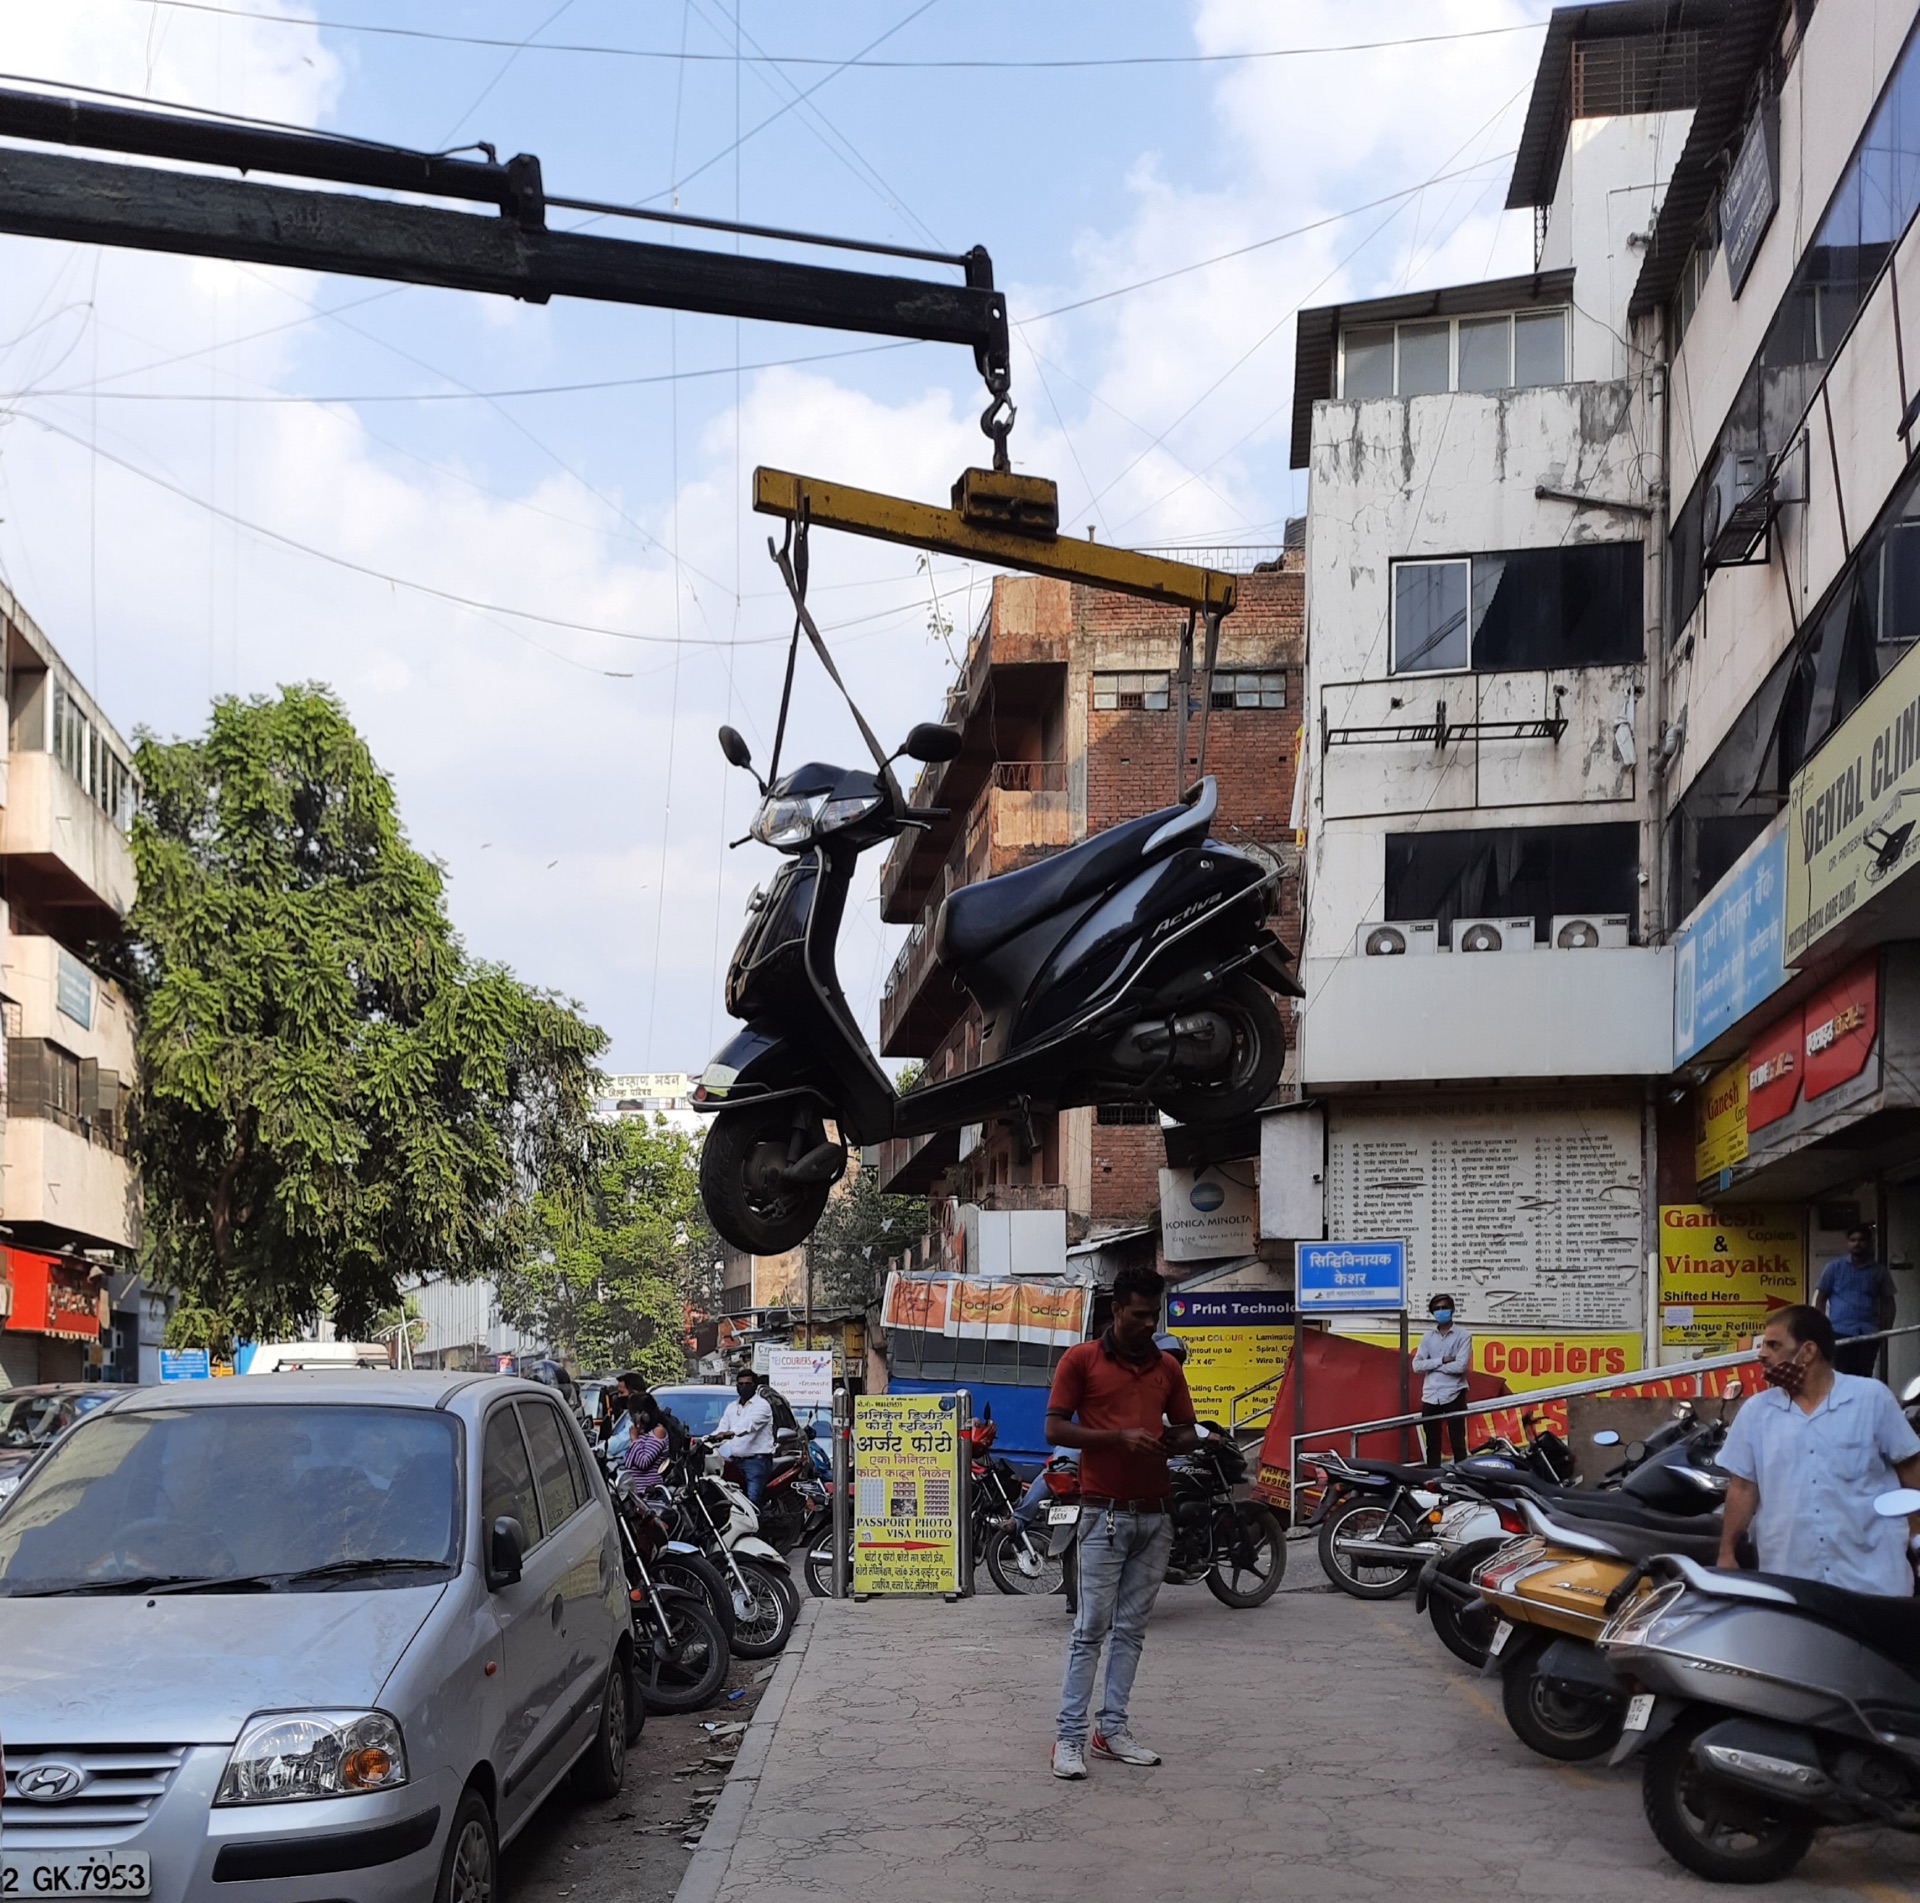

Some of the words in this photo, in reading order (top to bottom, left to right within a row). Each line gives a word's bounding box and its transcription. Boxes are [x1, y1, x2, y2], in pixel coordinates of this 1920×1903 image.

[1805, 756, 1864, 865] DENTAL
[1839, 879, 1857, 915] CLINIC
[1151, 893, 1223, 939] Activa
[1702, 914, 1717, 970] पुणे
[1719, 887, 1752, 941] पीपल्स
[1755, 863, 1775, 906] बँक
[1708, 1082, 1739, 1120] Ganesh
[1165, 1219, 1205, 1230] KONICA
[1207, 1215, 1253, 1227] MINOLTA
[1664, 1210, 1766, 1229] Ganesh
[1748, 1229, 1797, 1243] Copiers
[1714, 1236, 1728, 1252] &
[1310, 1250, 1391, 1269] सिद्धिविनायक
[1665, 1255, 1790, 1278] Vinayakk
[1334, 1271, 1366, 1286] केशर
[1760, 1275, 1797, 1286] Prints
[1664, 1292, 1708, 1301] Shifted
[1712, 1292, 1740, 1301] Here
[1192, 1303, 1227, 1315] Print
[1231, 1302, 1296, 1314] Technolo
[1725, 1321, 1766, 1331] Refillin
[1182, 1335, 1205, 1343] Digital
[781, 1356, 812, 1365] COURIERS
[1484, 1341, 1625, 1376] Copiers
[857, 1408, 902, 1420] अनिकेत
[865, 1419, 892, 1430] फोटो
[898, 1419, 943, 1432] स्टुडिओ
[857, 1431, 902, 1452] अर्जंट
[911, 1431, 952, 1452] फोटो
[870, 1456, 890, 1465] एका
[894, 1453, 937, 1465] मिनिटात
[856, 1466, 881, 1477] फोटो
[885, 1468, 915, 1480] काढून
[918, 1466, 951, 1478] मिळेल
[857, 1518, 912, 1527] PASSPORT
[915, 1518, 952, 1527] PHOTO
[887, 1529, 911, 1538] VISA
[915, 1529, 952, 1538] PHOTO
